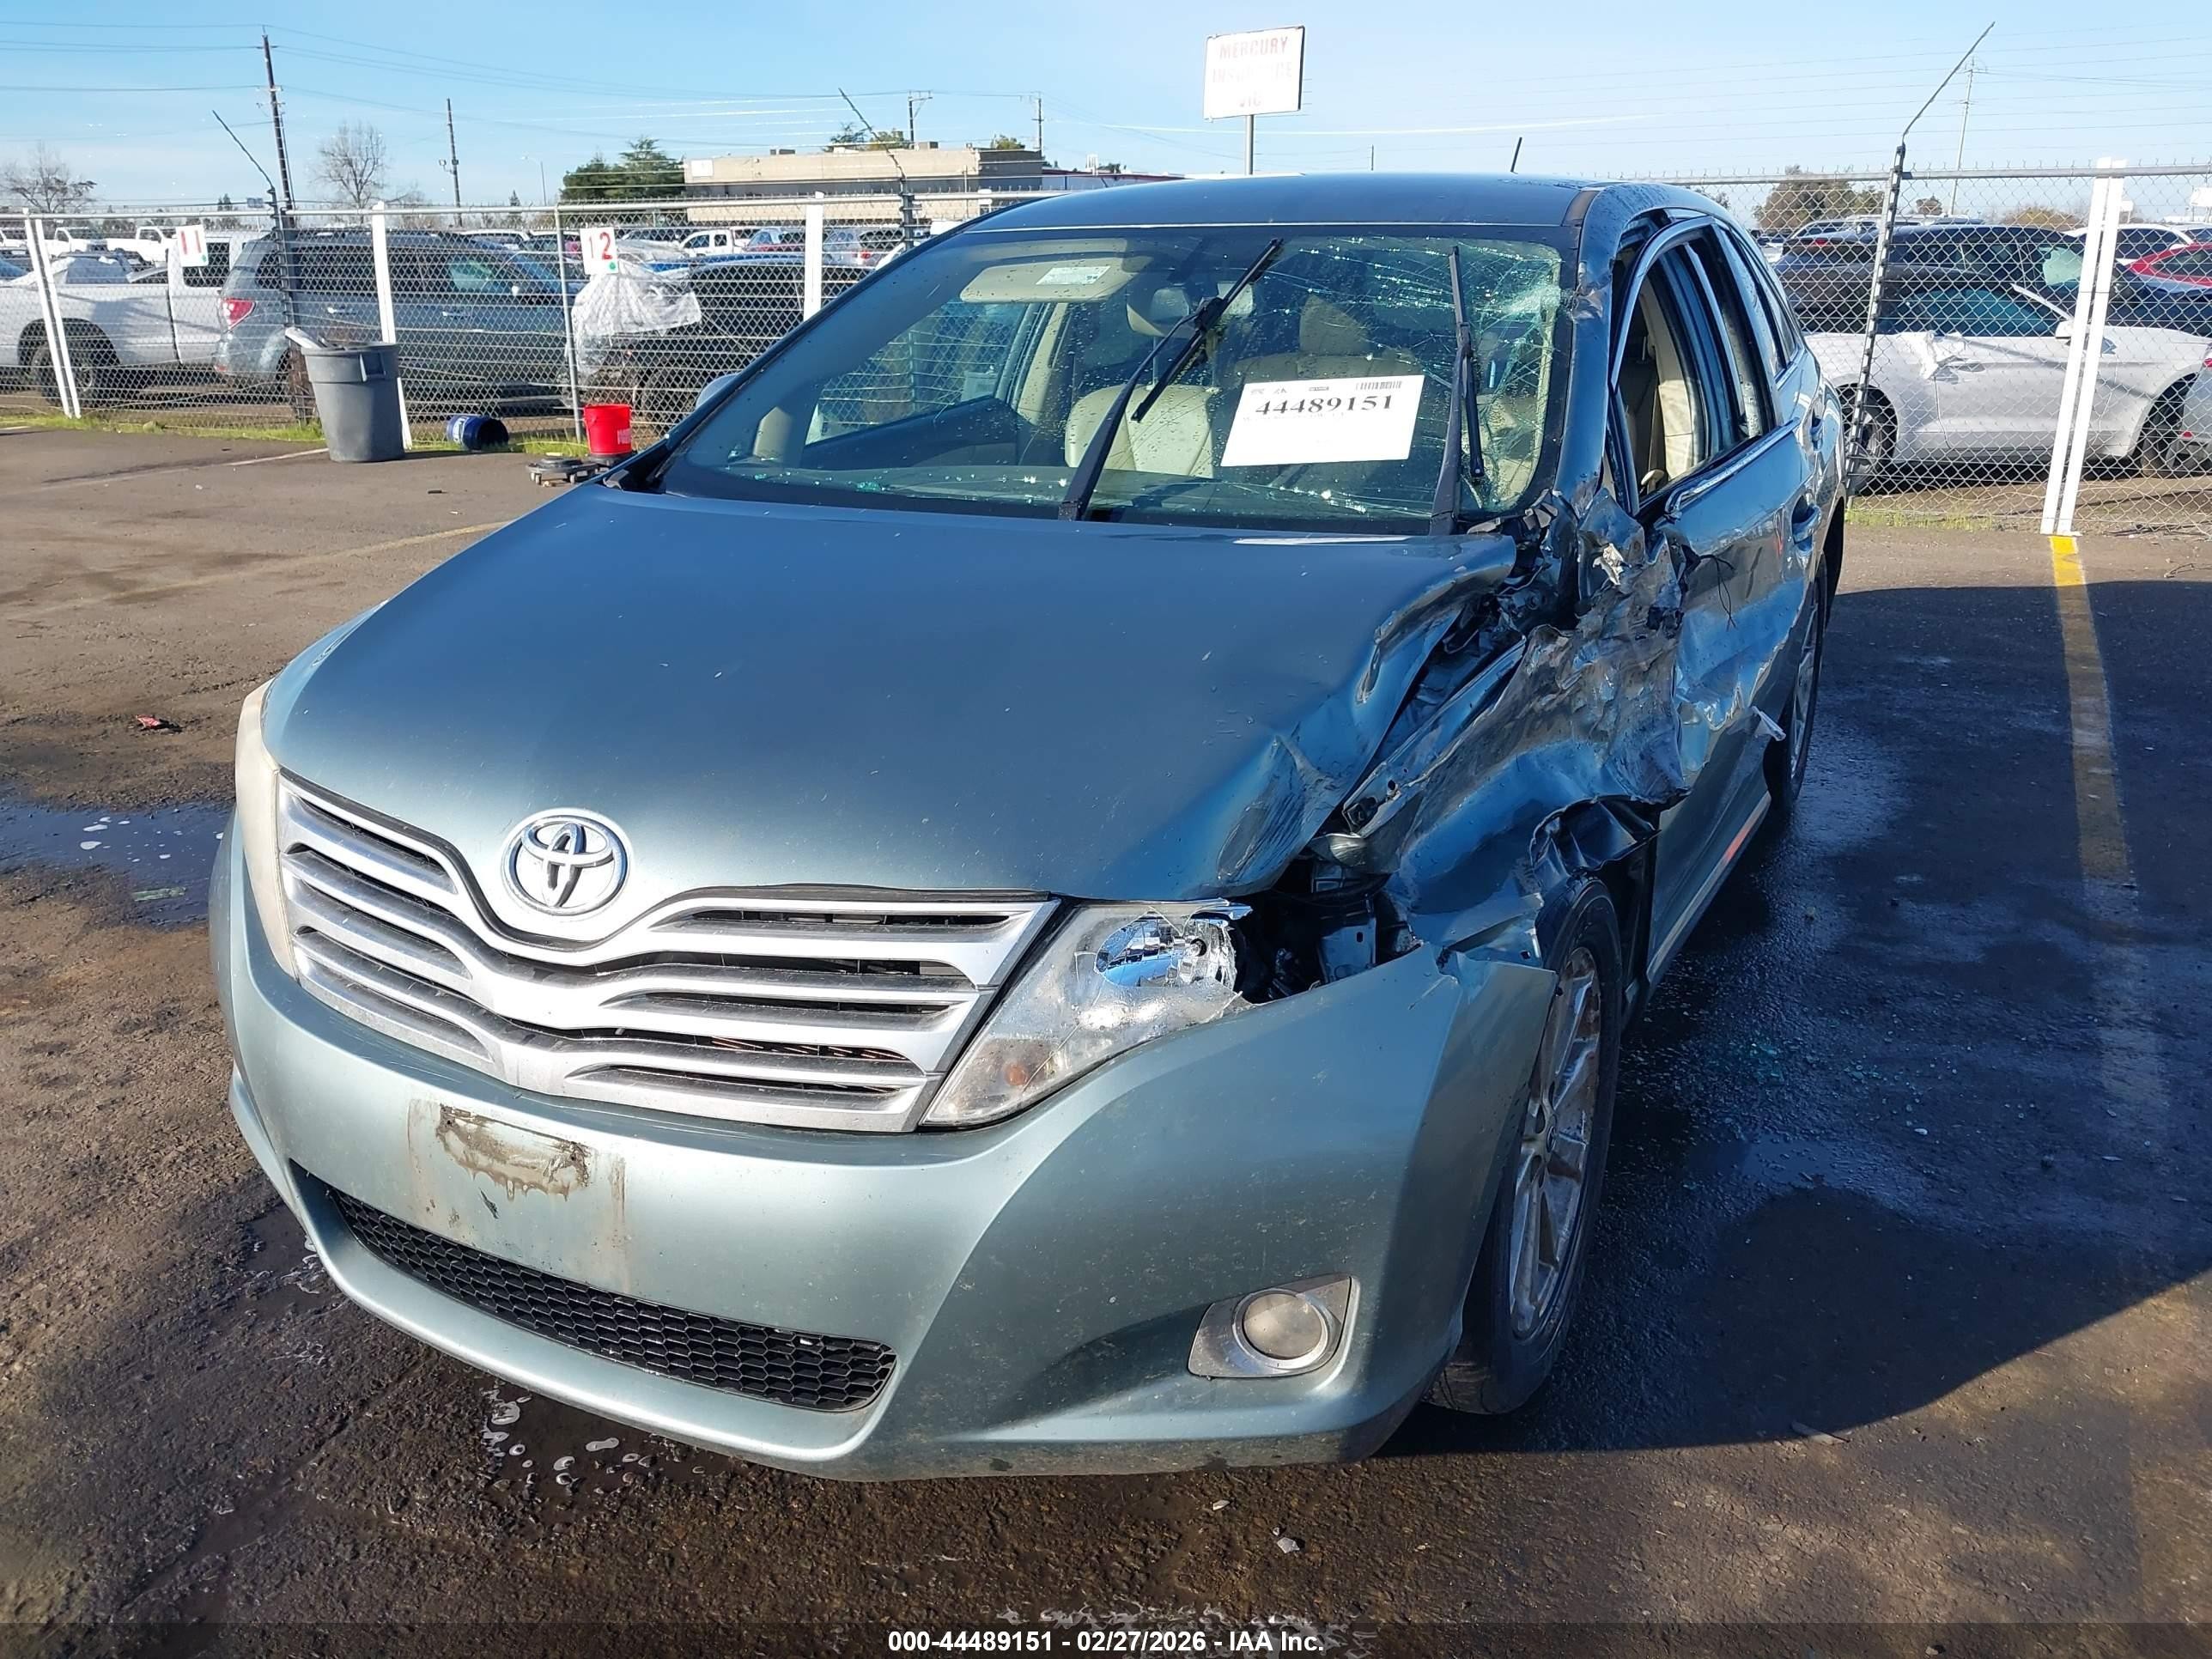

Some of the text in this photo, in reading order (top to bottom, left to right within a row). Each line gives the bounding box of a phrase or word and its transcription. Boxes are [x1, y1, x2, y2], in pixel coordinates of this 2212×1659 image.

[1219, 36, 1288, 59] MERCURY
[589, 232, 612, 259] 12
[1255, 394, 1393, 416] 44489151
